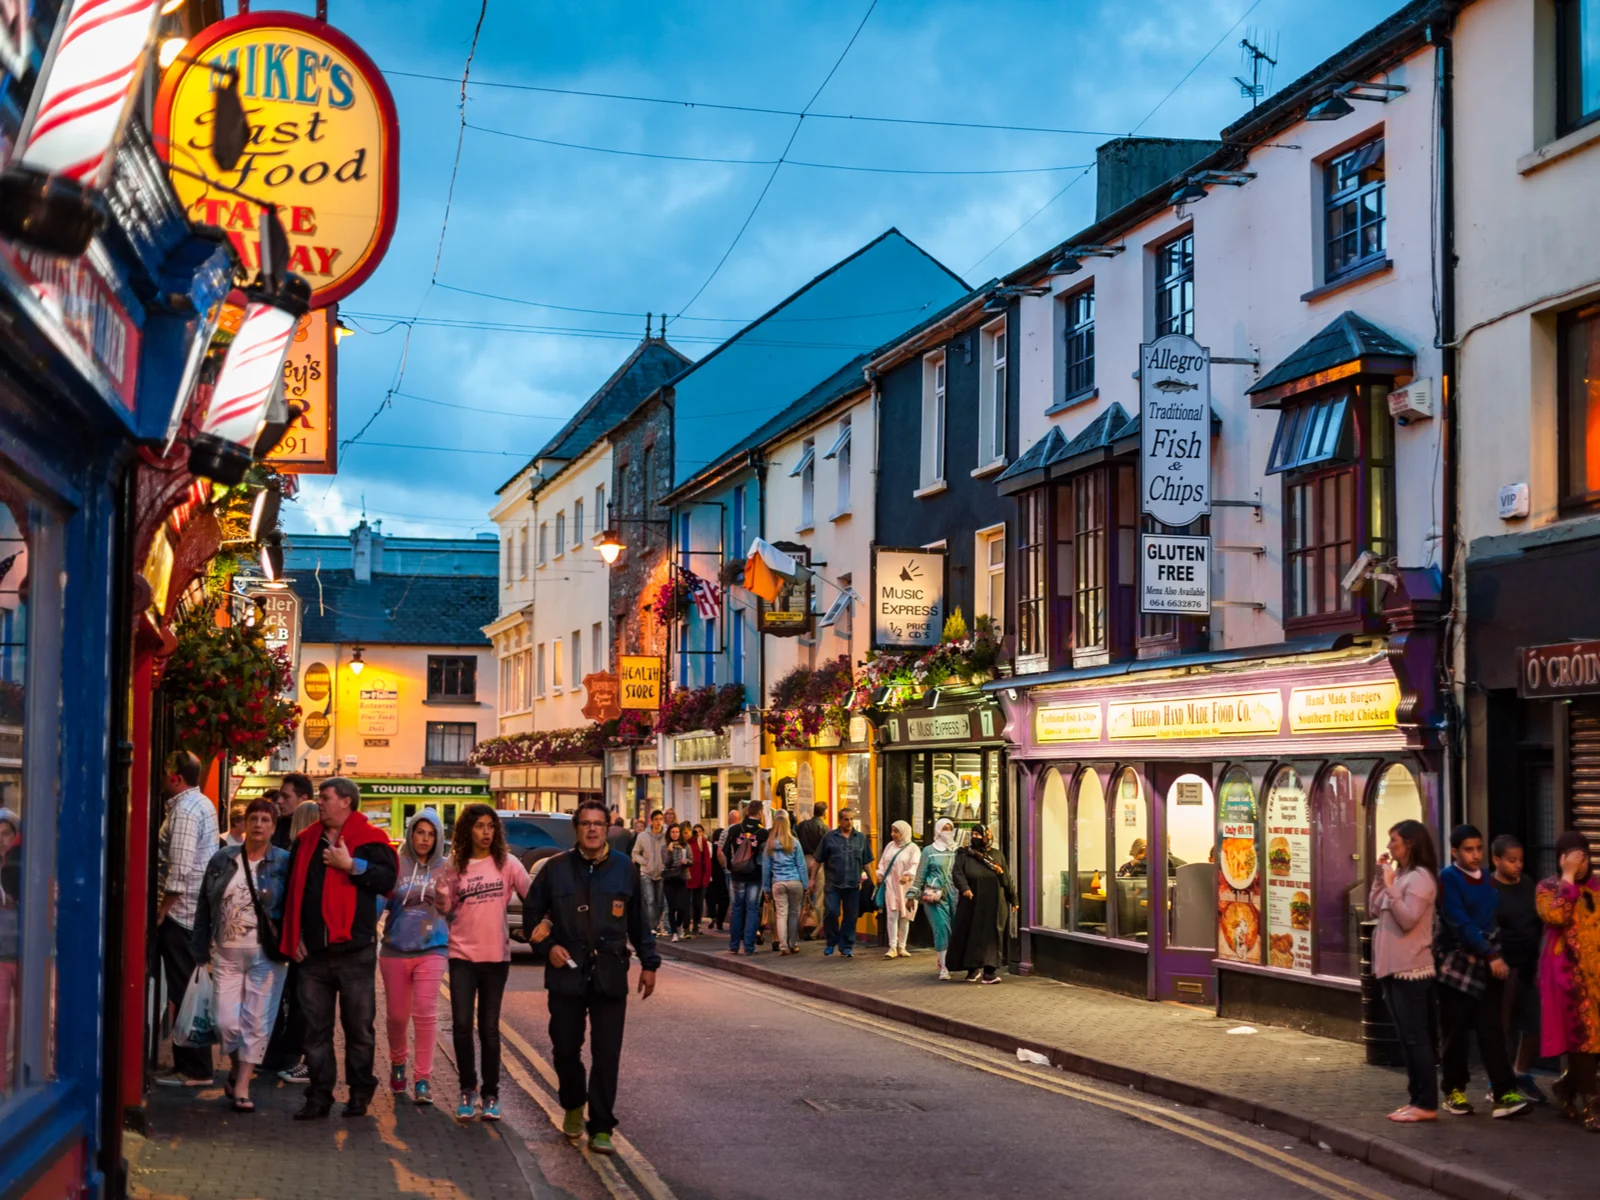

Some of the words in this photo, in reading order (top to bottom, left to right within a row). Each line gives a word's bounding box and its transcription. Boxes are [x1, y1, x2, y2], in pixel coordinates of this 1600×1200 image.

[209, 43, 355, 109] MIKE'S
[195, 198, 316, 236] TAE
[227, 230, 340, 276] AAY
[1147, 348, 1203, 373] Allegro
[1149, 402, 1203, 420] Traditional
[1149, 429, 1202, 458] Fish
[1168, 462, 1183, 470] &
[1149, 475, 1204, 505] Chips
[1501, 494, 1516, 507] VIP
[1147, 544, 1205, 561] GLUTEN
[1158, 564, 1194, 581] FREE
[882, 587, 924, 600] MUSIC
[1145, 586, 1163, 594] Menu
[1164, 586, 1177, 595] Also
[1178, 587, 1205, 596] Available
[882, 602, 939, 616] EXPRESS
[1167, 600, 1202, 608] 6632876
[622, 666, 659, 680] HEALTH
[625, 684, 655, 698] STORE
[1305, 694, 1325, 706] Hand
[1328, 693, 1347, 705] Made
[1350, 691, 1381, 706] Burgers
[1130, 708, 1160, 727] ALLEGRO
[1163, 705, 1184, 725] HAND
[1187, 703, 1208, 724] MADE
[1212, 701, 1234, 723] FOOD
[1298, 712, 1331, 725] Southern
[1334, 709, 1355, 723] Fried
[1357, 708, 1390, 721] Chicken
[371, 785, 425, 793] TOURIST
[428, 785, 472, 794] OFFICE
